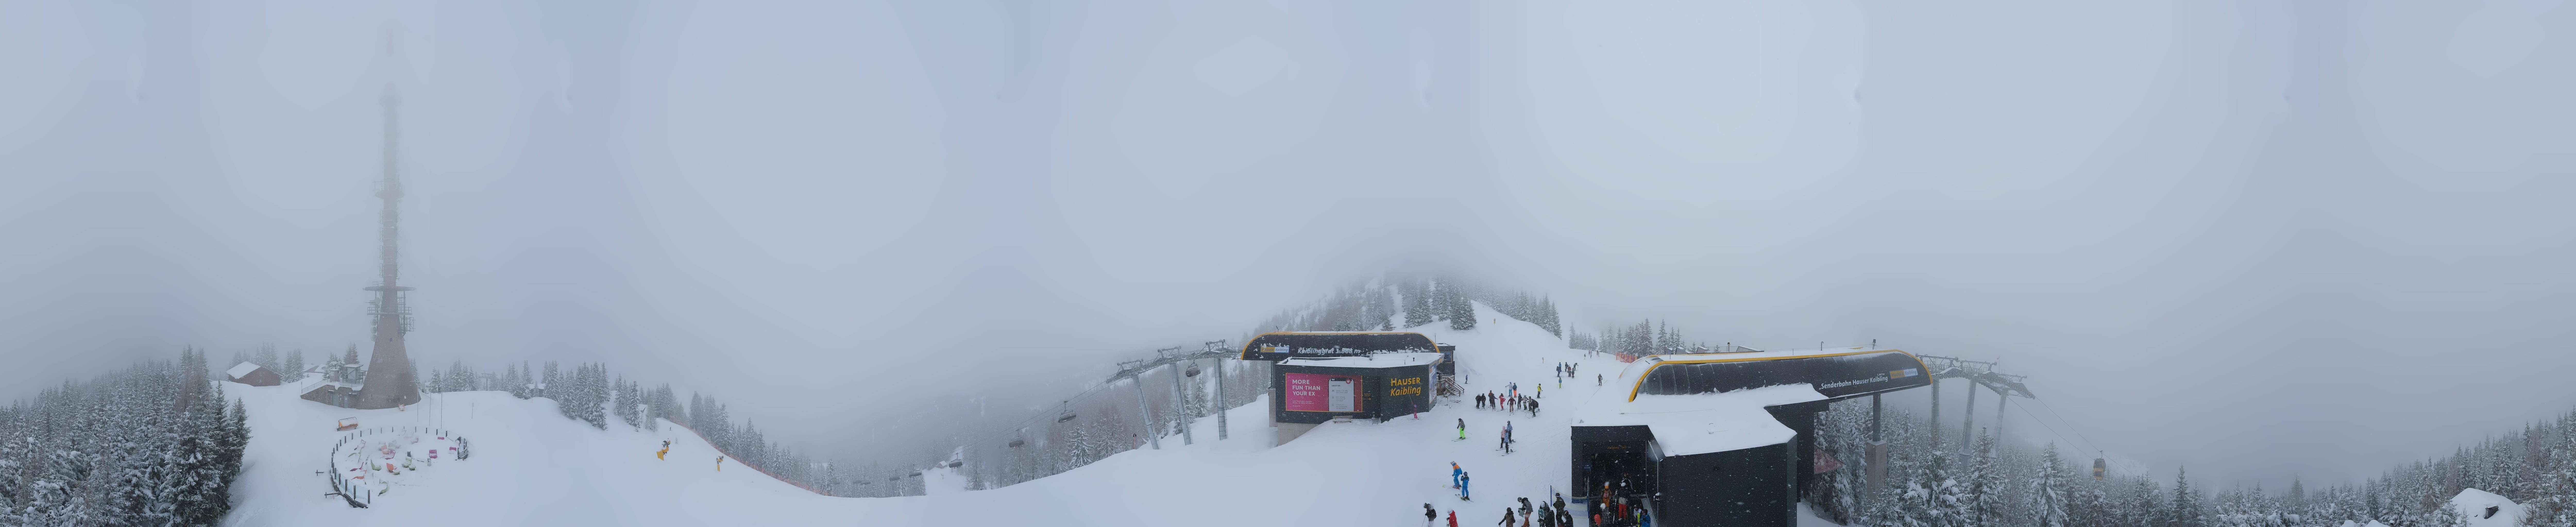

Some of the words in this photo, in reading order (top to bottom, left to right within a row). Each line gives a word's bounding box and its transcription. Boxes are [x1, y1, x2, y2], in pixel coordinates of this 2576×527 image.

[1391, 377, 1420, 386] HAUSER
[1821, 380, 1851, 389] Senderbahn
[1391, 386, 1421, 396] Kaibling
